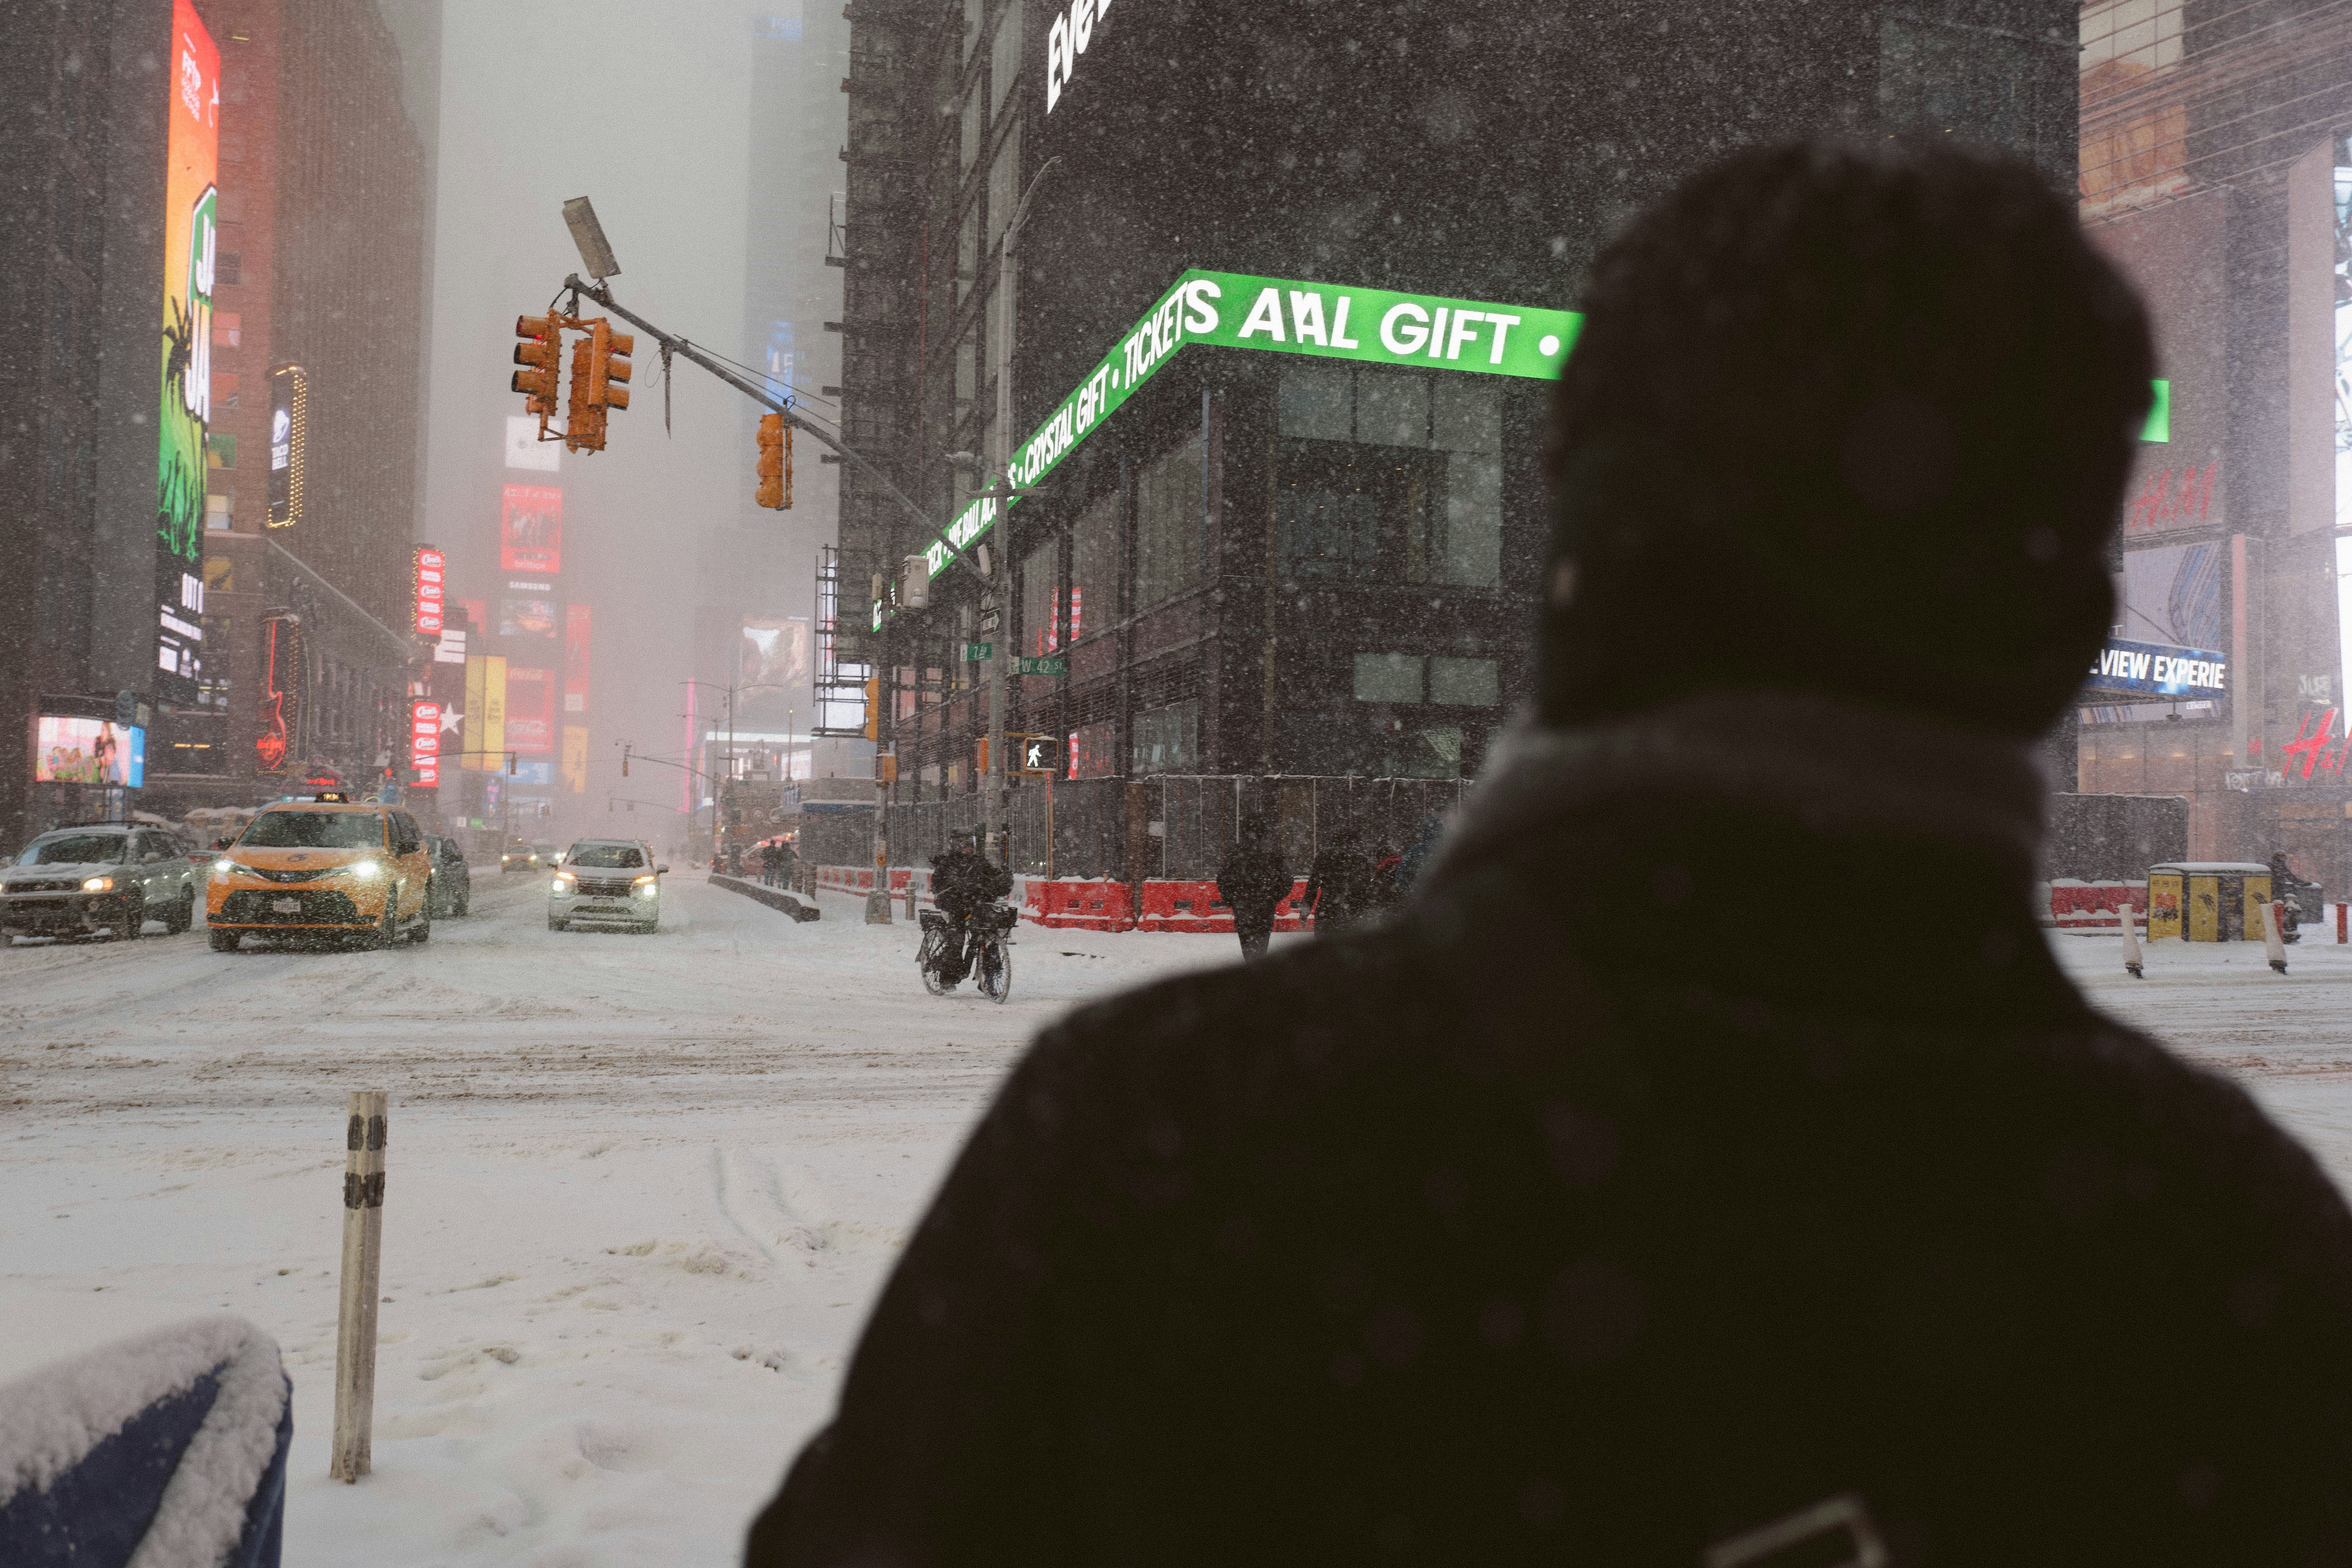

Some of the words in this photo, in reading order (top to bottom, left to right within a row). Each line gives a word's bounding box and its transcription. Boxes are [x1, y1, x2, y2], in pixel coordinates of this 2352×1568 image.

[962, 500, 980, 546] BALL
[1024, 402, 1074, 485] CRYSTAL
[1076, 363, 1110, 434] GIFT
[1124, 279, 1222, 390] TICKETS
[1380, 302, 1521, 365] GIFT
[272, 456, 289, 470] BELL
[973, 646, 978, 658] 7
[1022, 659, 1031, 672] W
[1036, 661, 1049, 673] 42
[2153, 655, 2226, 689] EXPERIE
[2281, 708, 2352, 780] H&
